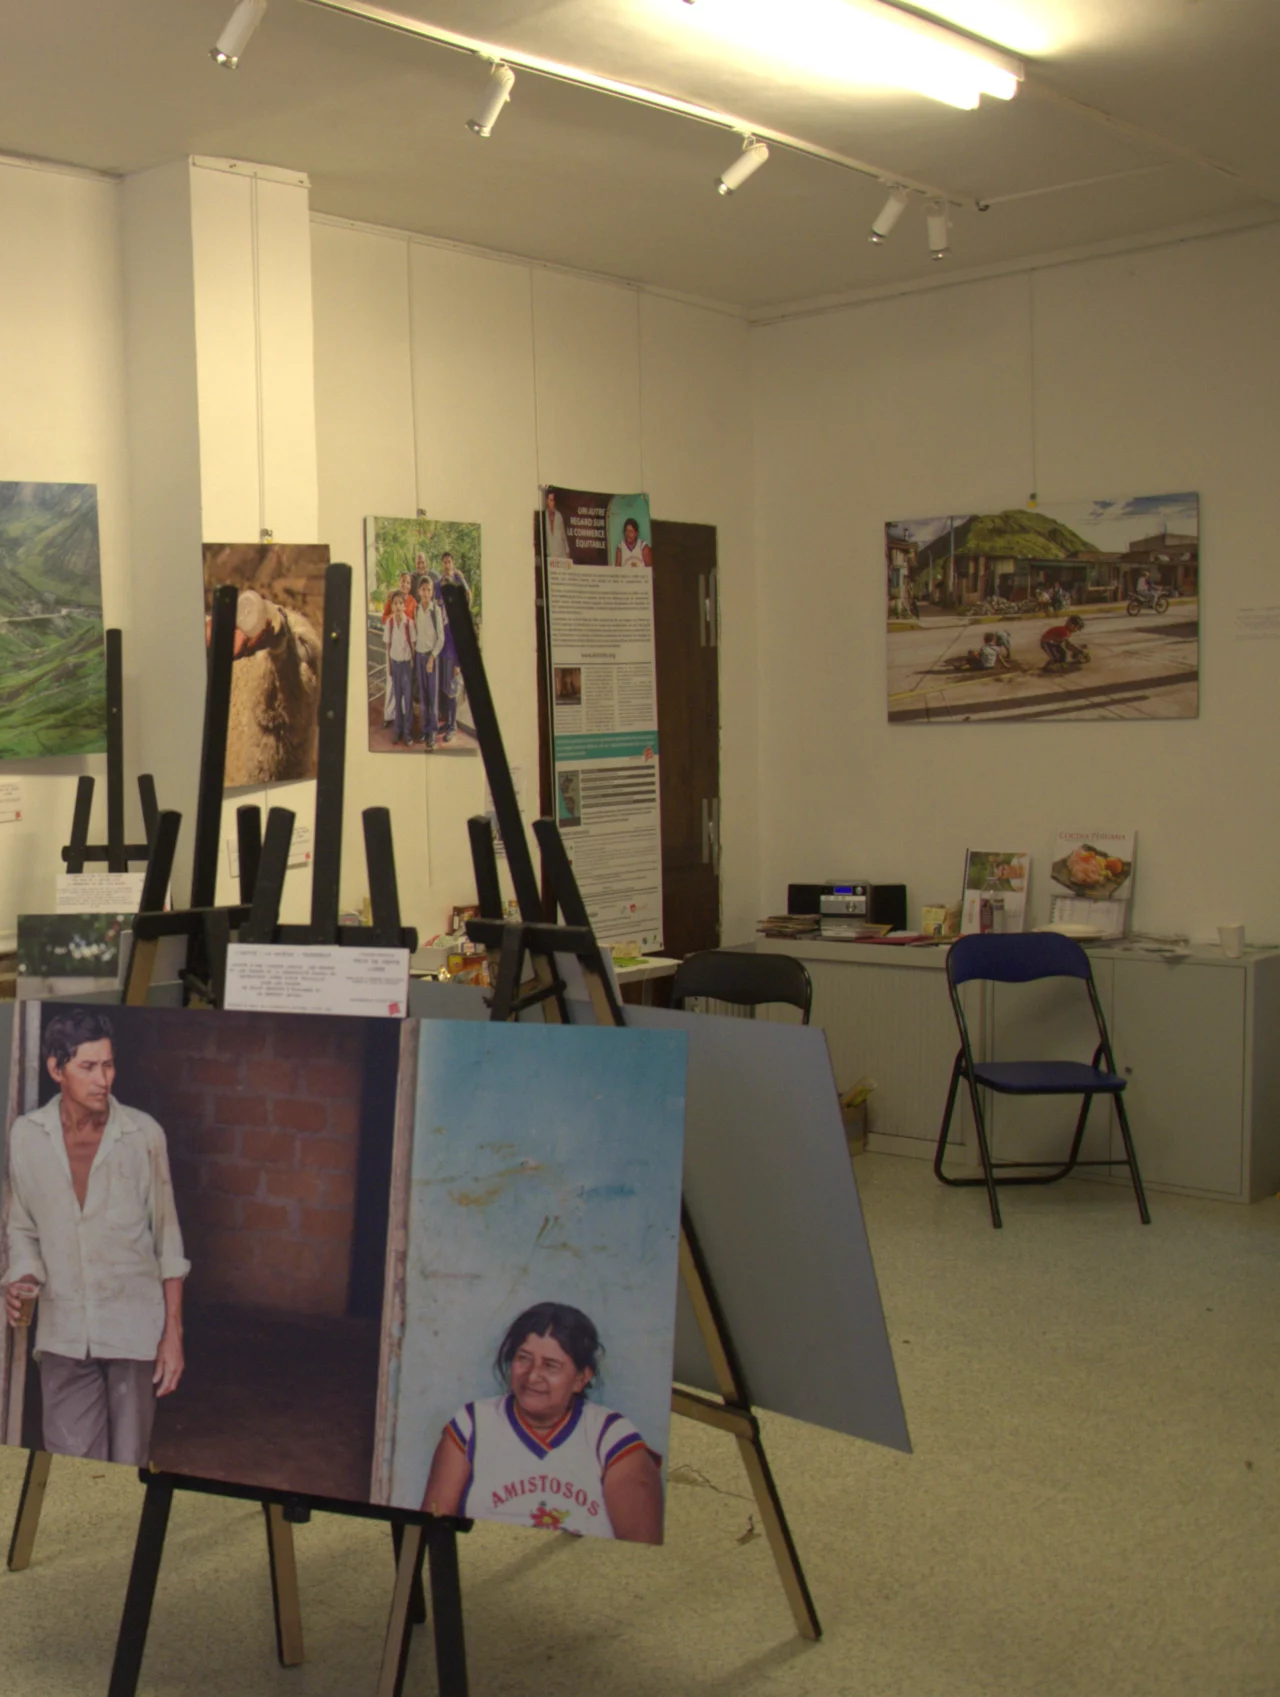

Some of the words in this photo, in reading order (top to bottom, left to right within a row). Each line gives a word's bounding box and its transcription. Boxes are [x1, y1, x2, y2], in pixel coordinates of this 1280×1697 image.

[570, 516, 593, 526] REGARD
[593, 518, 605, 527] SUR
[566, 527, 574, 536] LE
[574, 528, 606, 538] COMMERCE
[490, 1474, 601, 1517] AMISTOSOS
